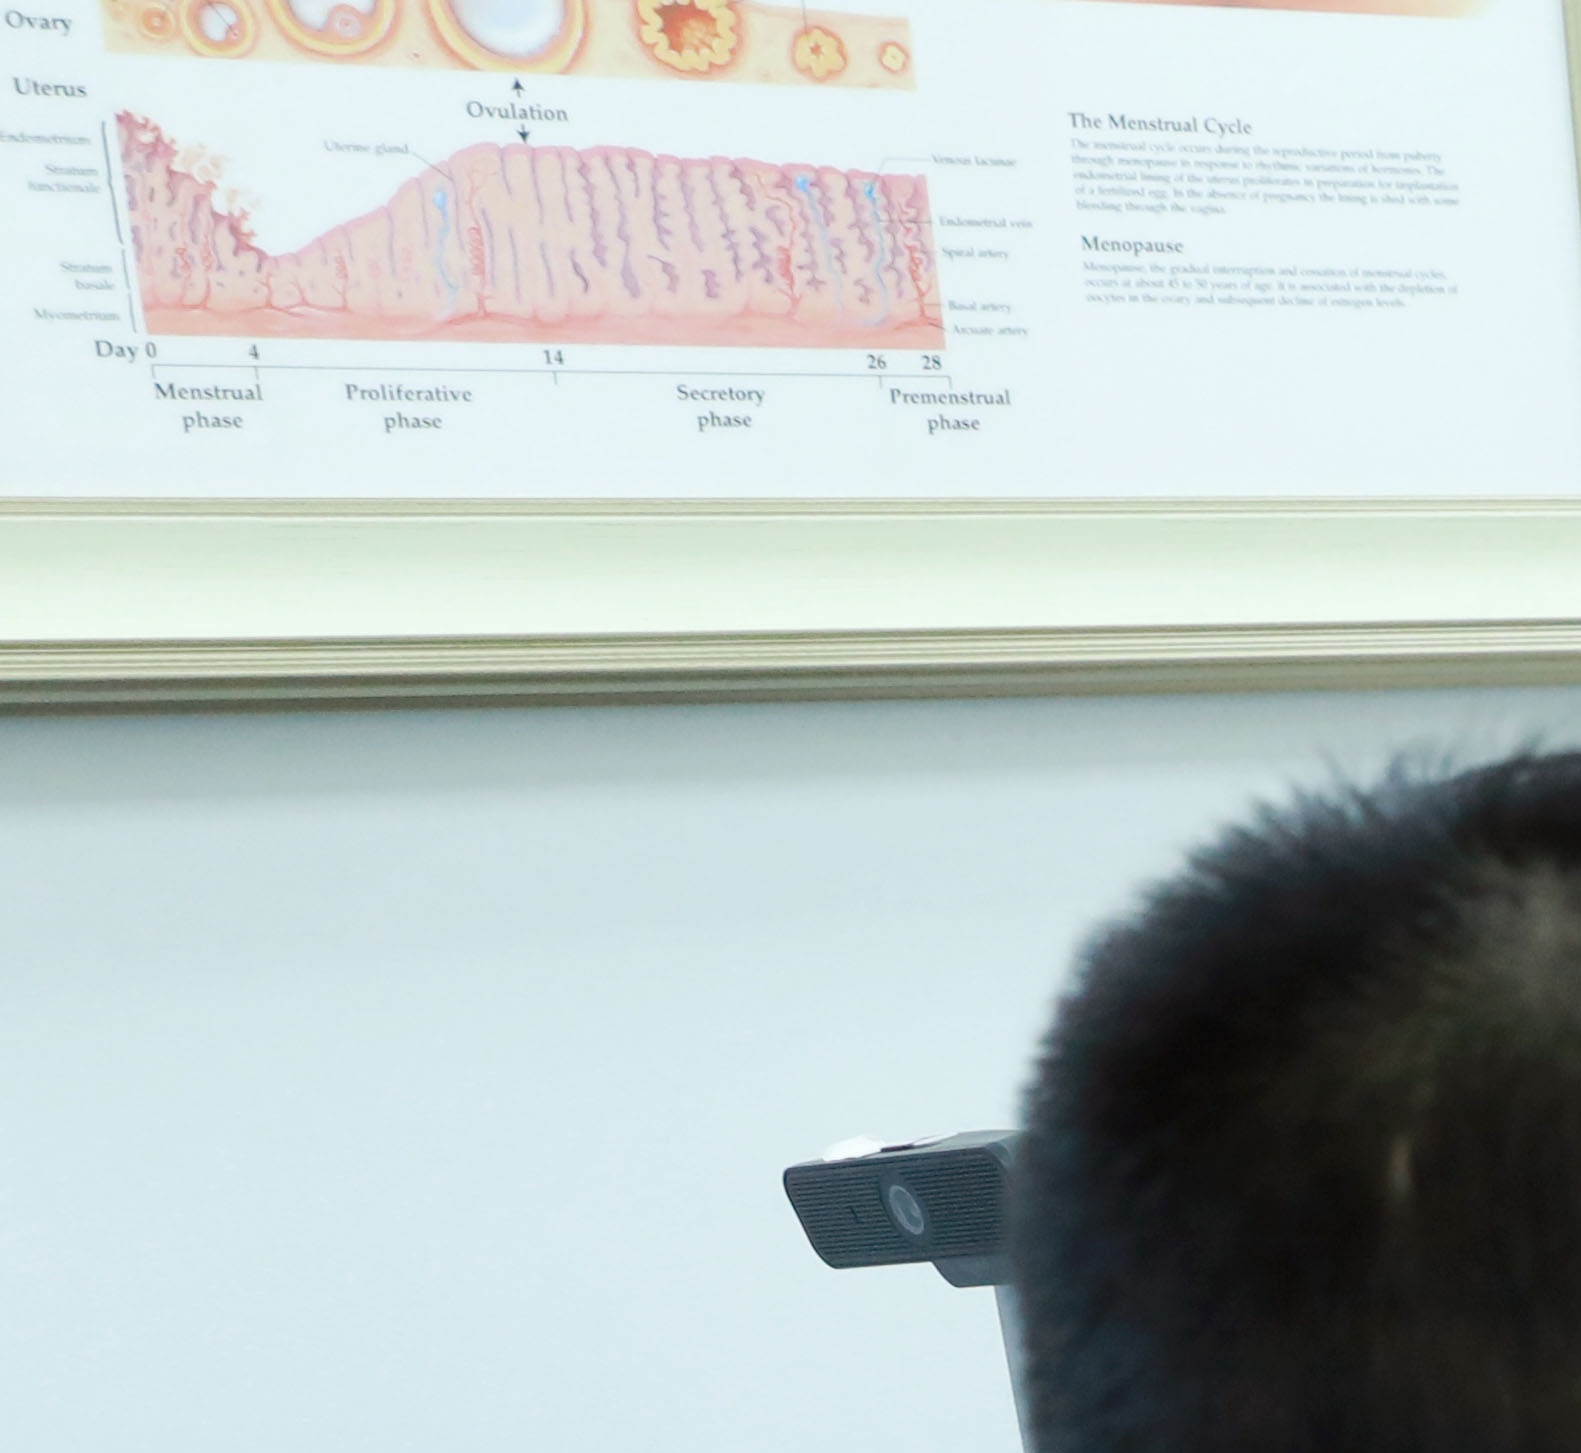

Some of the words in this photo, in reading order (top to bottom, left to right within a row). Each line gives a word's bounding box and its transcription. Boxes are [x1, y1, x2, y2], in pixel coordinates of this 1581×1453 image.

[5, 10, 72, 36] Ovary
[13, 77, 88, 99] Uterus
[466, 101, 569, 122] Ovulation
[1067, 112, 1102, 129] The
[1108, 115, 1198, 134] Menstrual
[1203, 118, 1252, 138] Cycle
[374, 143, 411, 157] gland
[1340, 148, 1373, 160] period
[1080, 235, 1184, 257] Menopause
[94, 340, 139, 363] Day
[146, 341, 158, 359] 0
[249, 344, 261, 360] 4
[543, 349, 564, 365] 14
[867, 354, 887, 370] 26
[922, 355, 942, 371] 28
[154, 383, 264, 402] Menstrual
[345, 383, 473, 402] Proliferative
[676, 384, 766, 407] Secretory
[890, 387, 1012, 408] Premenstrual
[183, 411, 244, 433] phase
[384, 411, 443, 433] phase
[697, 411, 753, 432] phase
[927, 412, 981, 436] phase
